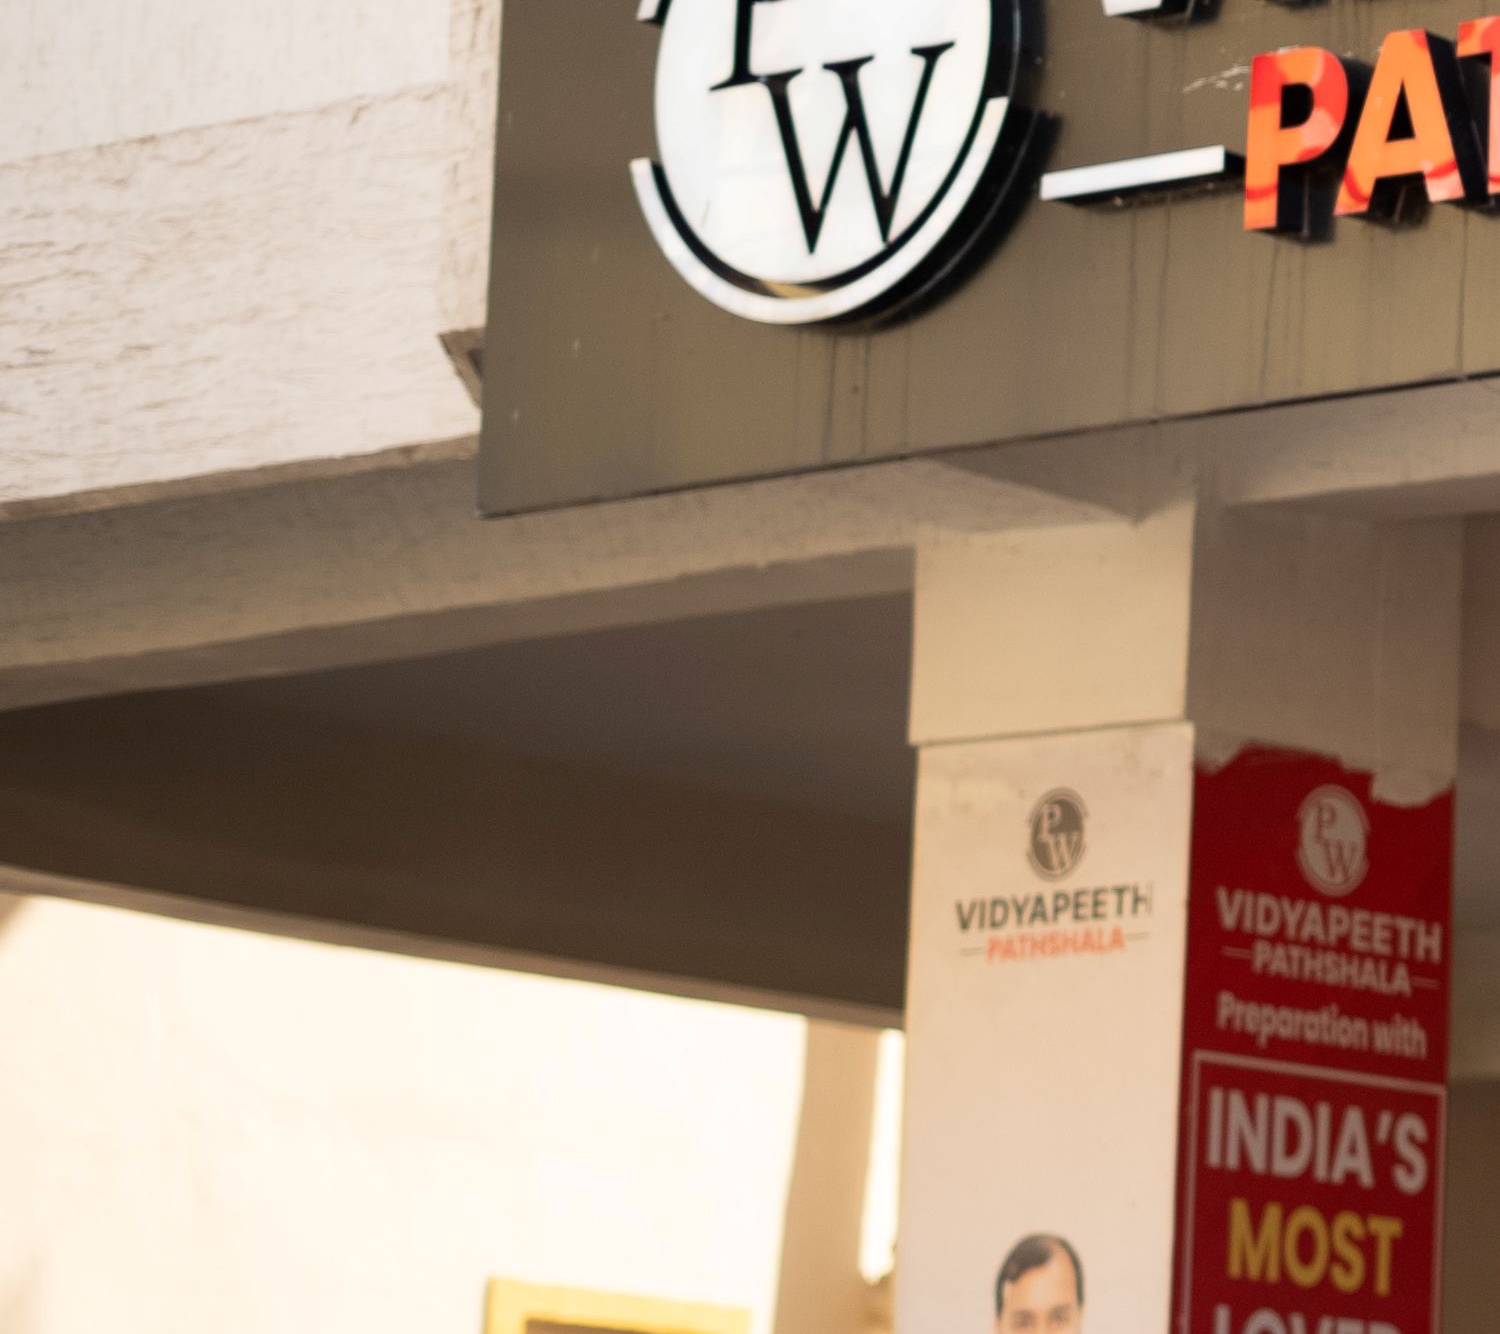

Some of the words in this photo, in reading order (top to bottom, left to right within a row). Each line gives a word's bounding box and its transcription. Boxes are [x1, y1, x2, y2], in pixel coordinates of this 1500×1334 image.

[954, 880, 1154, 934] VIDYAPEETH
[1215, 884, 1444, 965] VIDYAPEETH
[985, 925, 1127, 964] PATHSHALA
[1251, 938, 1412, 998] PATHSHALA
[1215, 988, 1370, 1049] Preparation
[1371, 1011, 1428, 1061] with
[1206, 1085, 1430, 1197] INDIA'S
[1226, 1195, 1405, 1299] MOST
